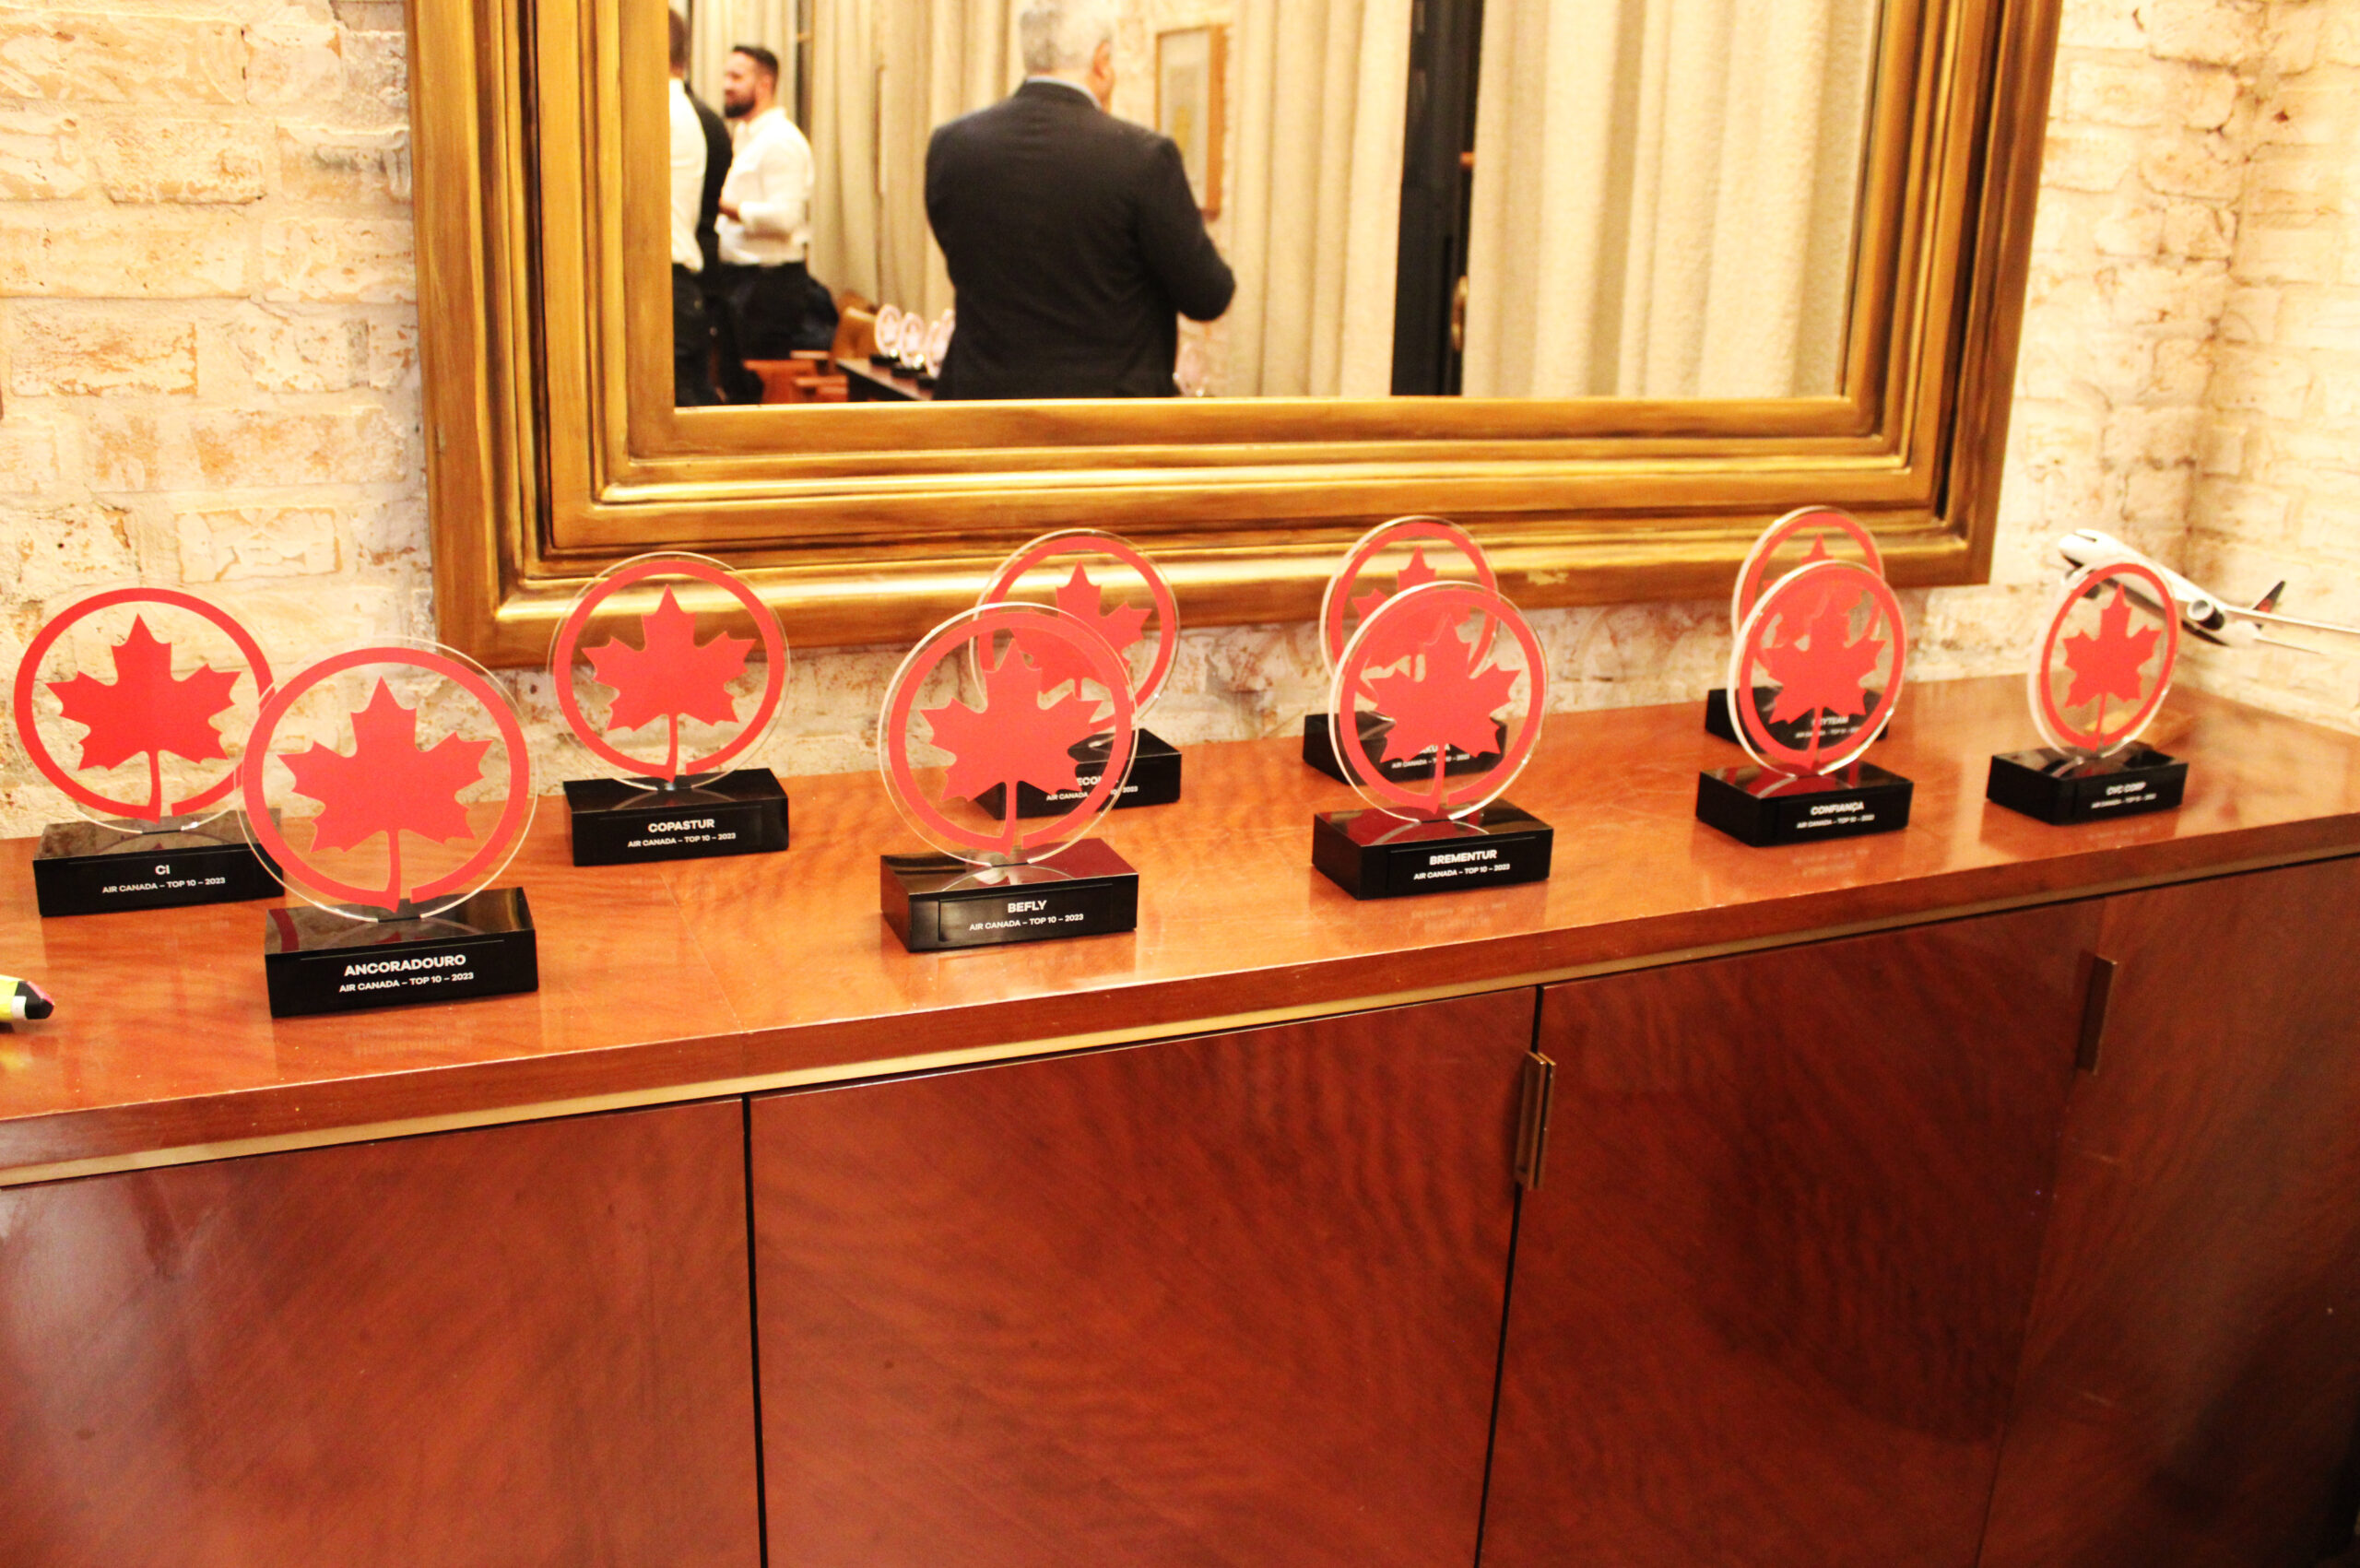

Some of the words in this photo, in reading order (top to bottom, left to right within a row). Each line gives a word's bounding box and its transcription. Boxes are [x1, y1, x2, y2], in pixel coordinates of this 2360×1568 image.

[1059, 792, 1088, 800] CANADA
[1811, 801, 1864, 816] CONFIANÇA
[648, 819, 715, 833] COPASTUR
[642, 837, 677, 846] CANADA
[717, 832, 736, 841] 2023
[1429, 849, 1497, 866] BREMENTUR
[155, 865, 170, 876] CI
[1427, 869, 1457, 878] CANADA
[1493, 863, 1510, 872] 2023
[119, 883, 159, 892] CANADA
[167, 880, 184, 889] TOP
[205, 877, 226, 885] 2023
[1008, 900, 1047, 914] BEFLY
[985, 920, 1021, 929] CANADA
[1029, 917, 1046, 925] TOP
[1047, 915, 1056, 924] 10
[1065, 914, 1084, 922] 2023
[344, 954, 466, 976] ANCORADOURO
[338, 984, 357, 993] AIR
[357, 979, 400, 991] CANADA
[409, 977, 430, 985] TOP
[431, 975, 442, 984] 10
[451, 973, 474, 982] 2023
